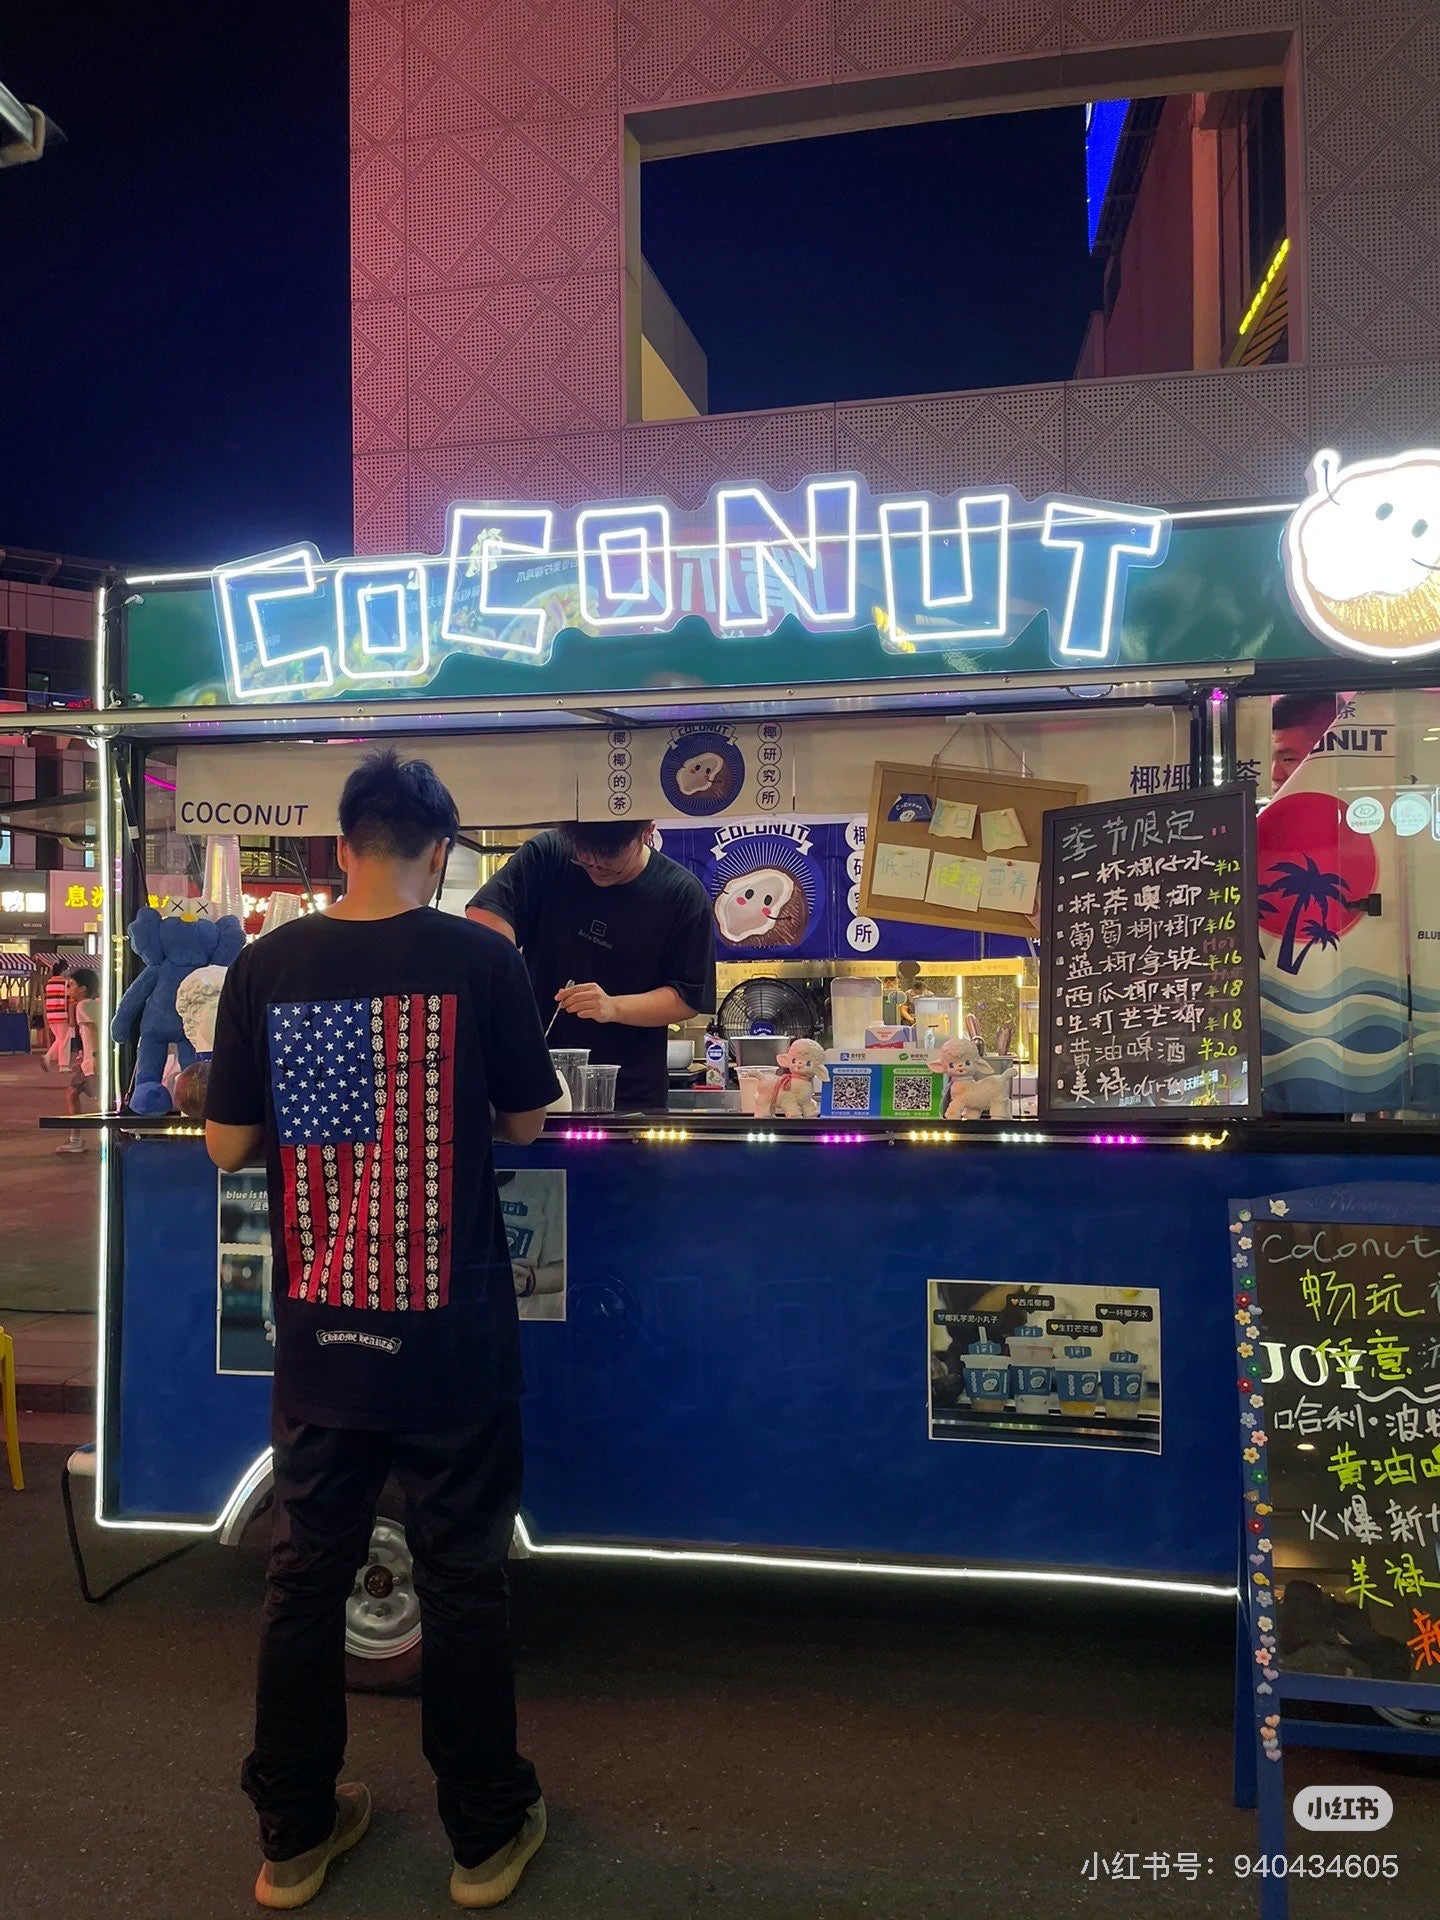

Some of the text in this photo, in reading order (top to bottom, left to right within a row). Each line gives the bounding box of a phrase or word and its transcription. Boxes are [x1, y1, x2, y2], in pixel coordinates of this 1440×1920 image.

[218, 480, 1162, 698] COCONUT
[612, 731, 628, 810] 椰椰的茶
[761, 725, 777, 804] 椰研究所
[181, 801, 309, 826] COCONUT
[717, 823, 808, 844] COCONUT
[1062, 810, 1204, 862] 季节限定
[1069, 913, 1205, 952] 葡萄椰椰
[1066, 945, 1201, 980] 蓝椰拿铁
[1065, 978, 1202, 1008] 西瓜椰椰
[1070, 1031, 1186, 1067] 黄油啤酒
[1259, 1341, 1367, 1389] JOY
